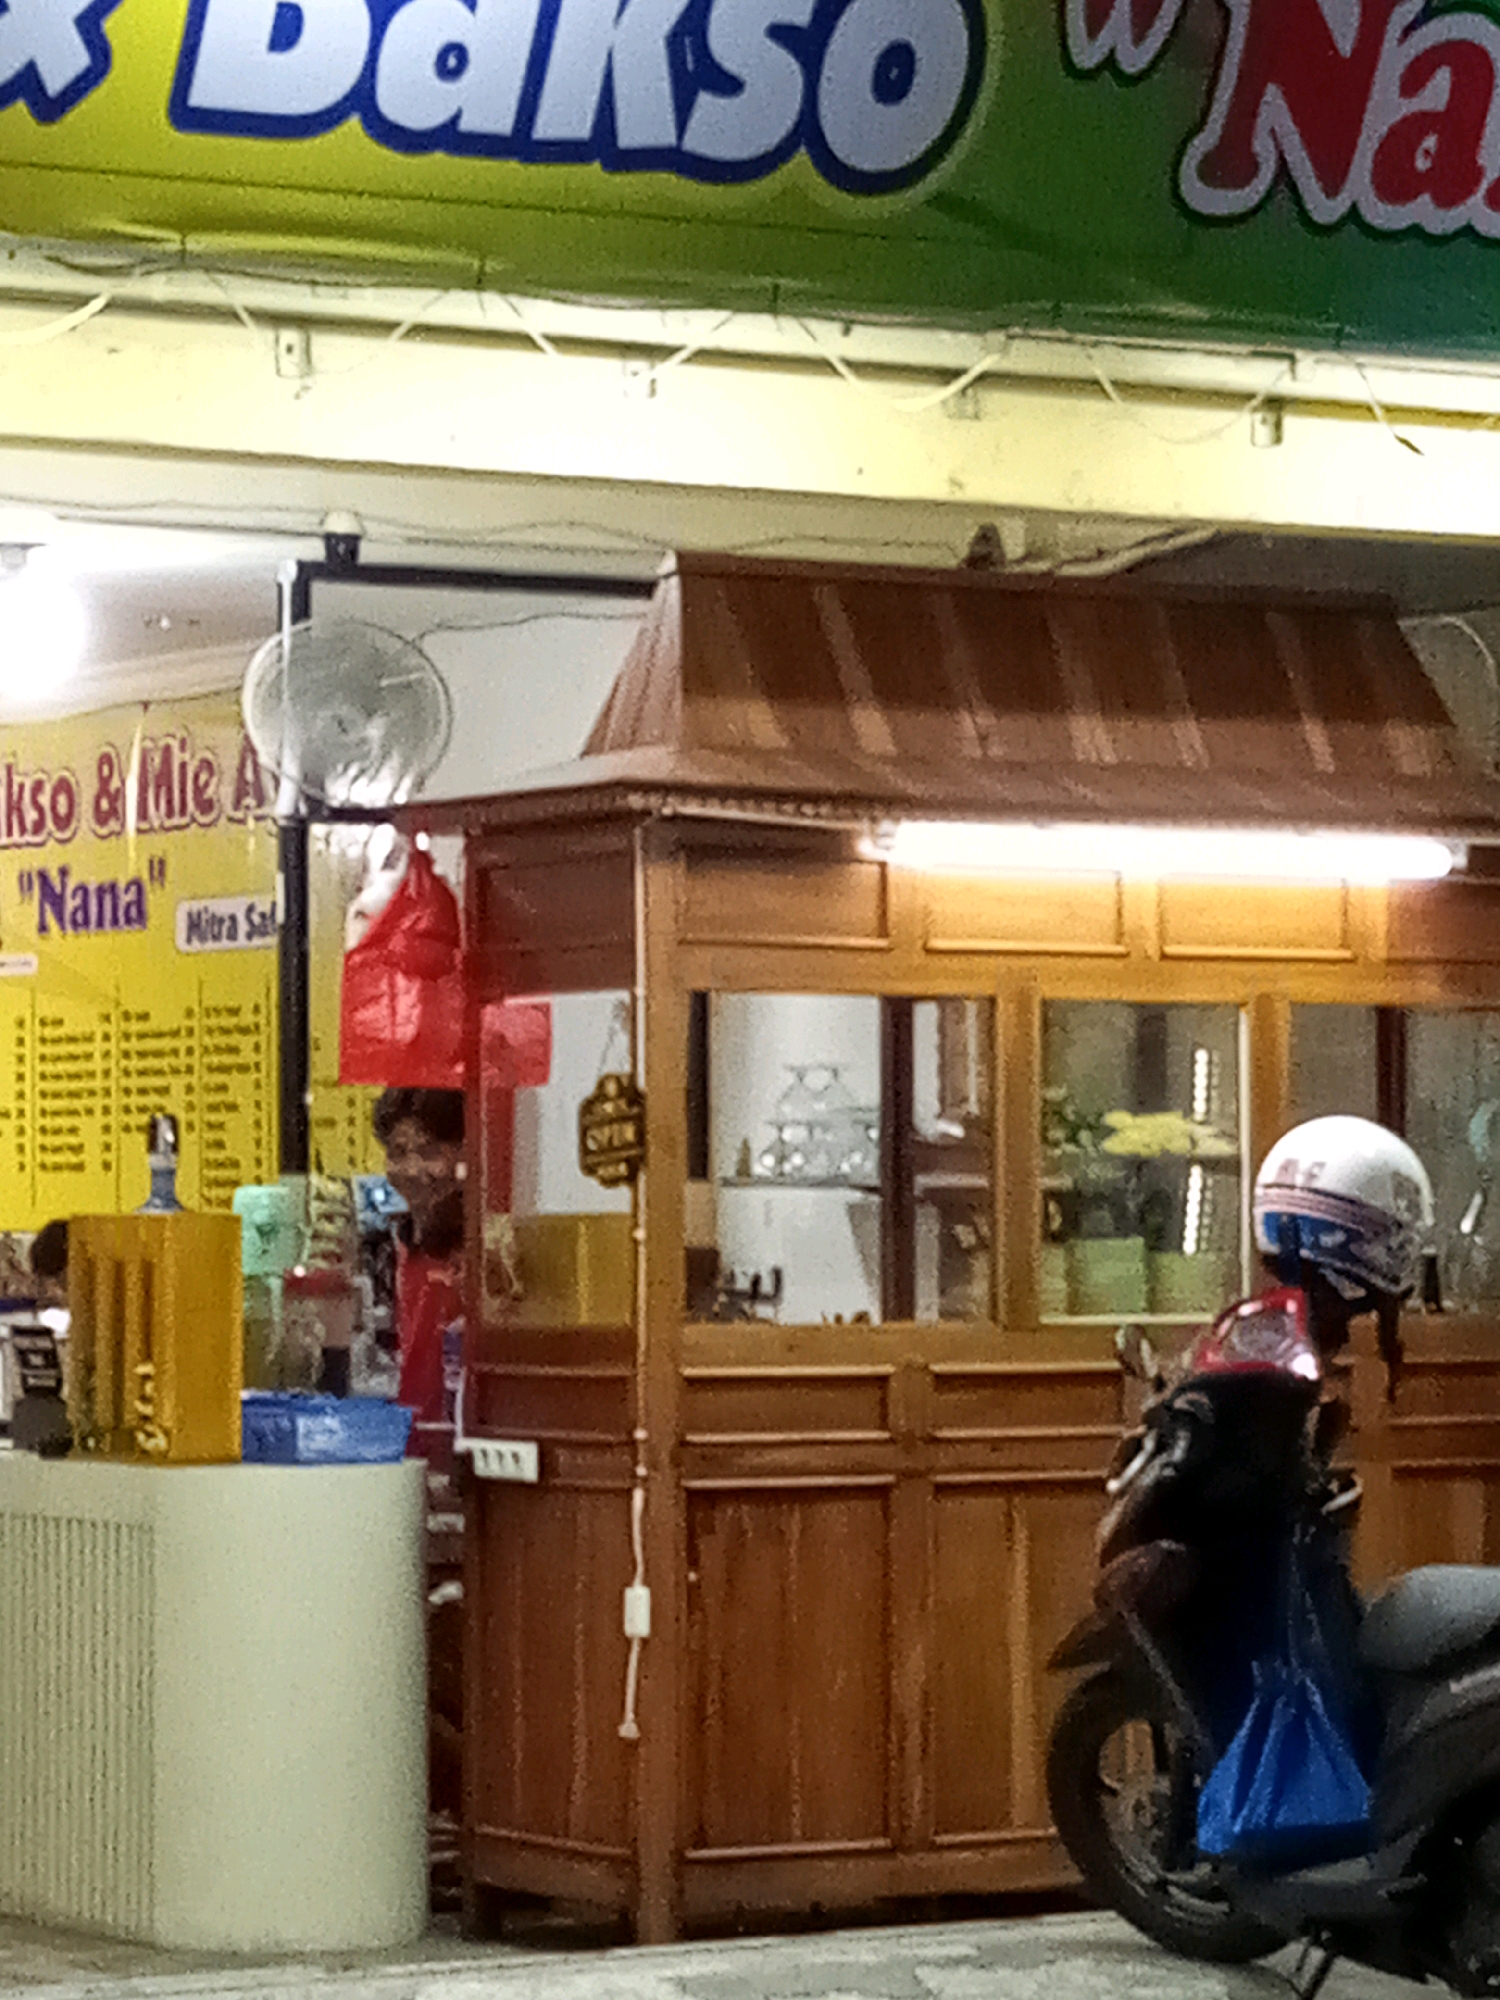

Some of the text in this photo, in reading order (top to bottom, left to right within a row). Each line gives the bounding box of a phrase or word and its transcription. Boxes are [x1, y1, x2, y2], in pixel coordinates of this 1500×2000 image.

[0, 760, 77, 841] kso
[92, 751, 124, 831] &
[134, 736, 216, 824] Mie
